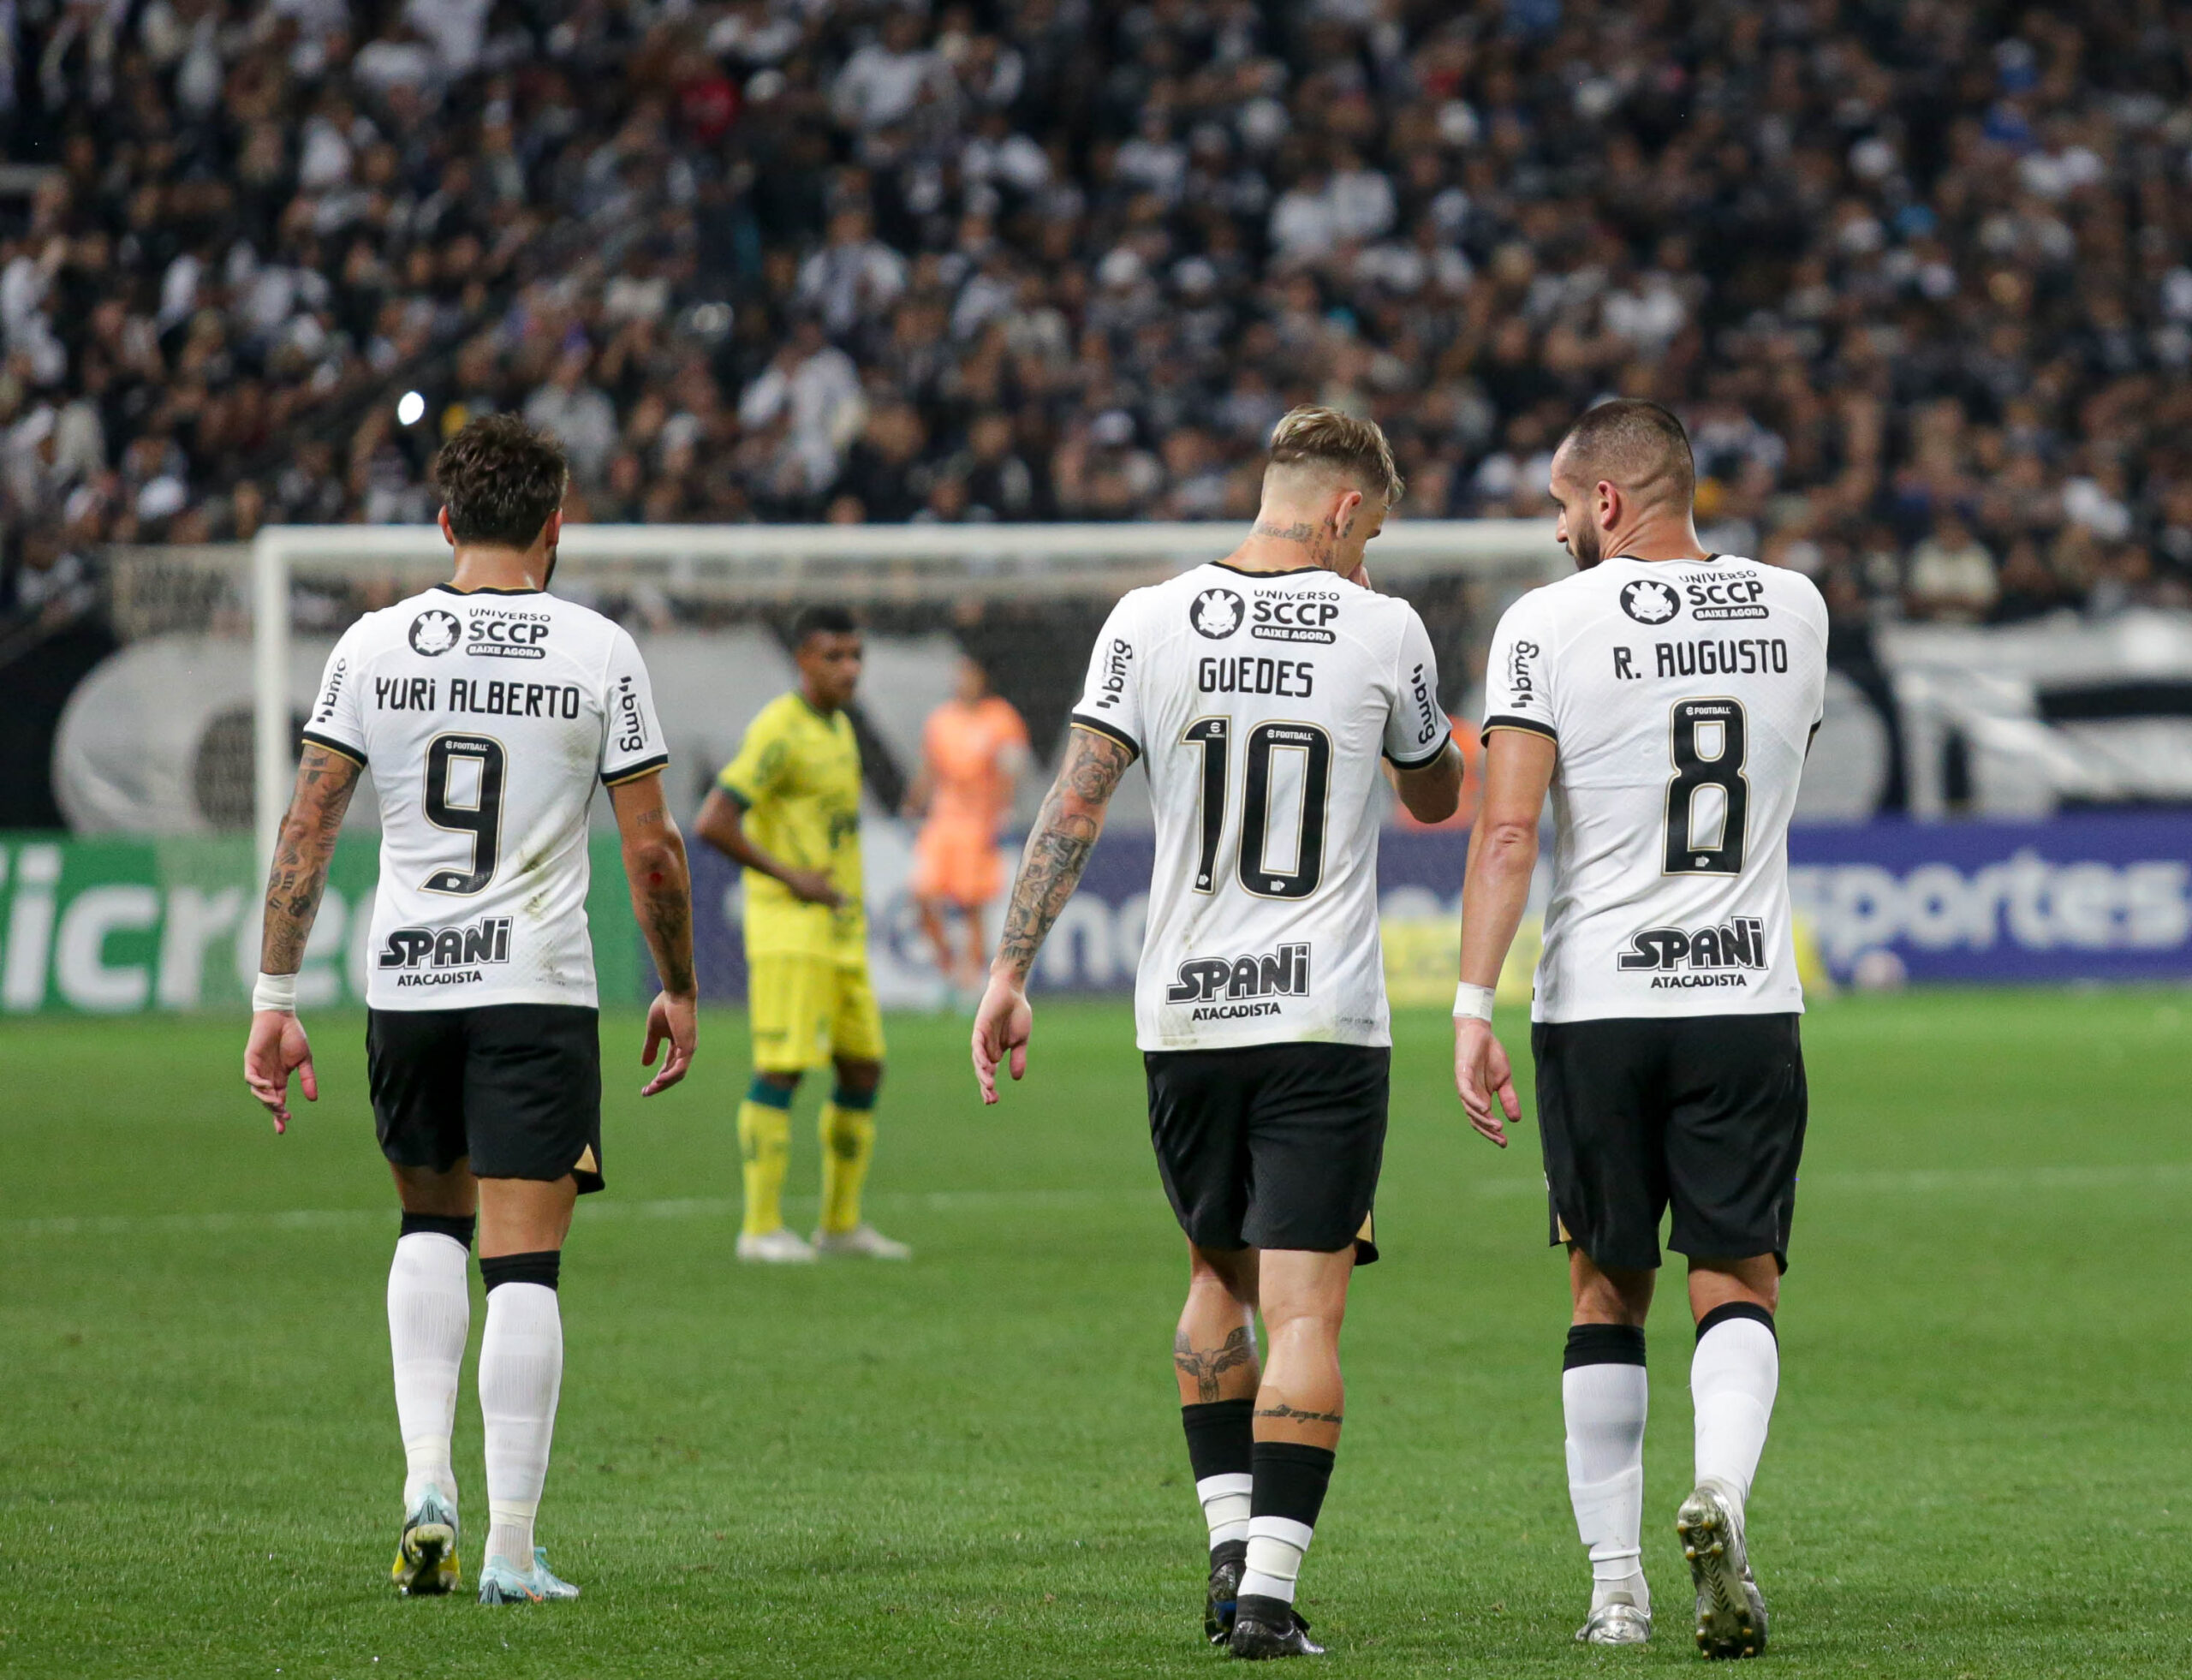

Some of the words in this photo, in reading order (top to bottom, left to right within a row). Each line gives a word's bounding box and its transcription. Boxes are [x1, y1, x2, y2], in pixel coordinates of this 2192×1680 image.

[1678, 569, 1757, 584] UNIVERSO
[1254, 589, 1340, 602] UNIVERSO
[1686, 580, 1764, 606] SCCP
[469, 607, 551, 623] UNIVERSO
[1252, 599, 1339, 627] SCCP
[1695, 609, 1729, 619] BAIXE
[1730, 607, 1766, 617] AGORA
[468, 619, 549, 645] SCCP
[1254, 627, 1290, 639] BAIXE
[1290, 629, 1332, 642] AGORA
[468, 645, 502, 654] BAIXE
[502, 646, 542, 658] AGORA
[1102, 638, 1133, 693] bmg
[1612, 646, 1642, 680] R.
[1655, 638, 1789, 678] AUGUSTO
[1199, 657, 1314, 699] GUEDES
[1510, 640, 1540, 692] bmg
[448, 677, 581, 720] ALBERTO
[619, 693, 644, 753] bmg
[1414, 682, 1436, 745] bmg
[1660, 695, 1751, 878] 8
[417, 730, 509, 897] 9
[1178, 714, 1334, 902] 10
[0, 842, 378, 1012] icre
[396, 970, 483, 987] ATACADISTA
[1650, 974, 1748, 989] ATACADISTA
[1191, 1002, 1282, 1022] ATACADISTA
